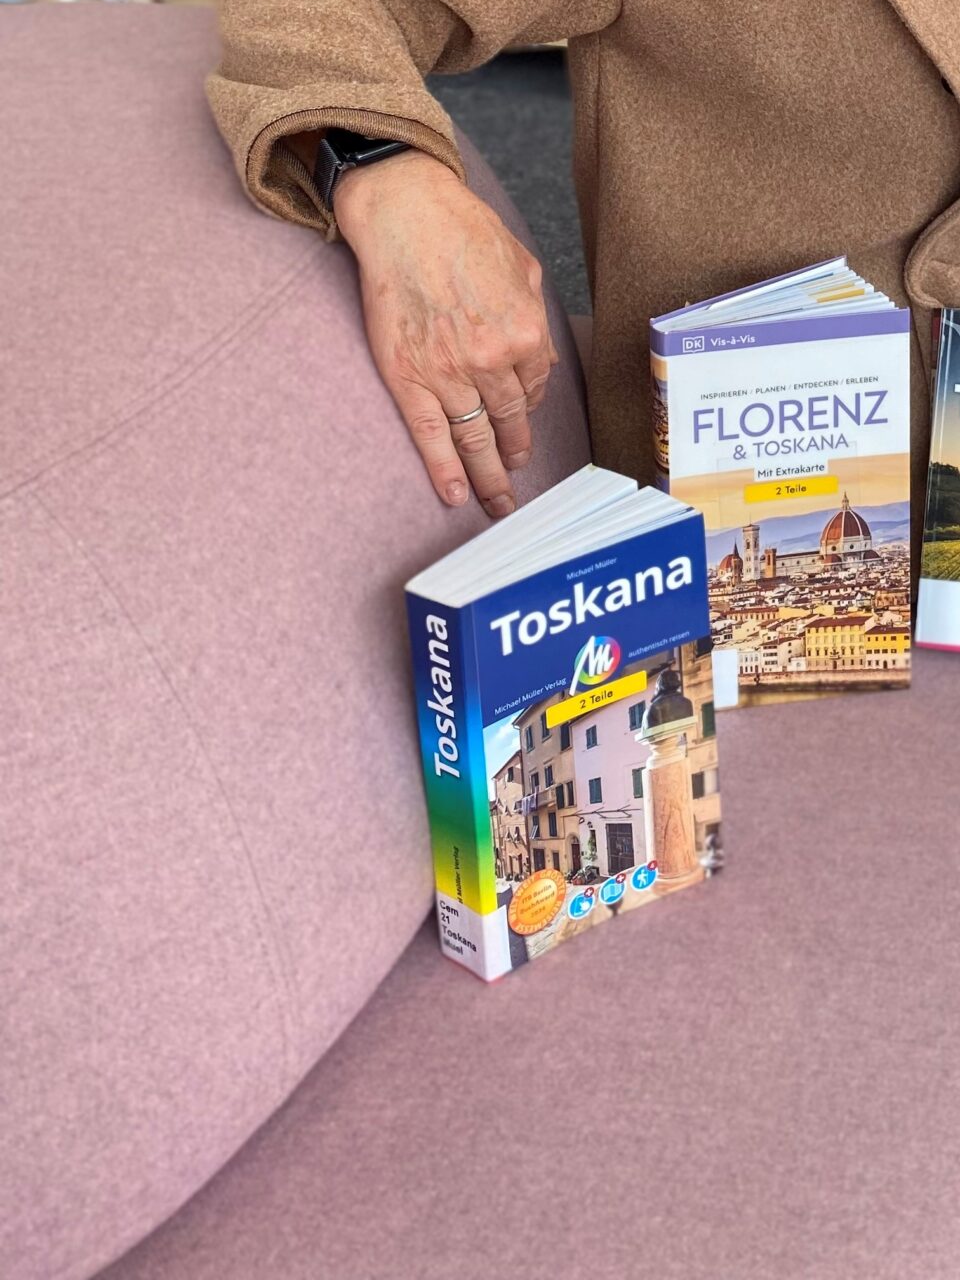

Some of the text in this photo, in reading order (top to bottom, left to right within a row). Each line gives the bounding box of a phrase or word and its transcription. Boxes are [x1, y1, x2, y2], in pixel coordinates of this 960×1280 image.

[684, 335, 755, 351] DK Vis-à-Vis
[700, 389, 748, 400] INSPIRIEREN
[756, 385, 786, 395] PLANEN
[794, 380, 839, 390] ENTDECKEN
[846, 376, 879, 385] ERLEBEN
[693, 390, 889, 444] FLORENZ
[733, 433, 849, 460] & TOSKANA
[758, 463, 825, 478] Mit Extrakarte
[776, 484, 806, 495] 2 Teile
[566, 557, 618, 581] Michael Müller
[490, 555, 693, 656] Toskana
[628, 630, 690, 658] authentisch reisen
[426, 614, 460, 778] Toskana
[494, 676, 567, 716] Michael Müller Verlag
[580, 690, 613, 709] 2 Teile
[441, 913, 450, 924] 21
[442, 925, 477, 952] Toskana
